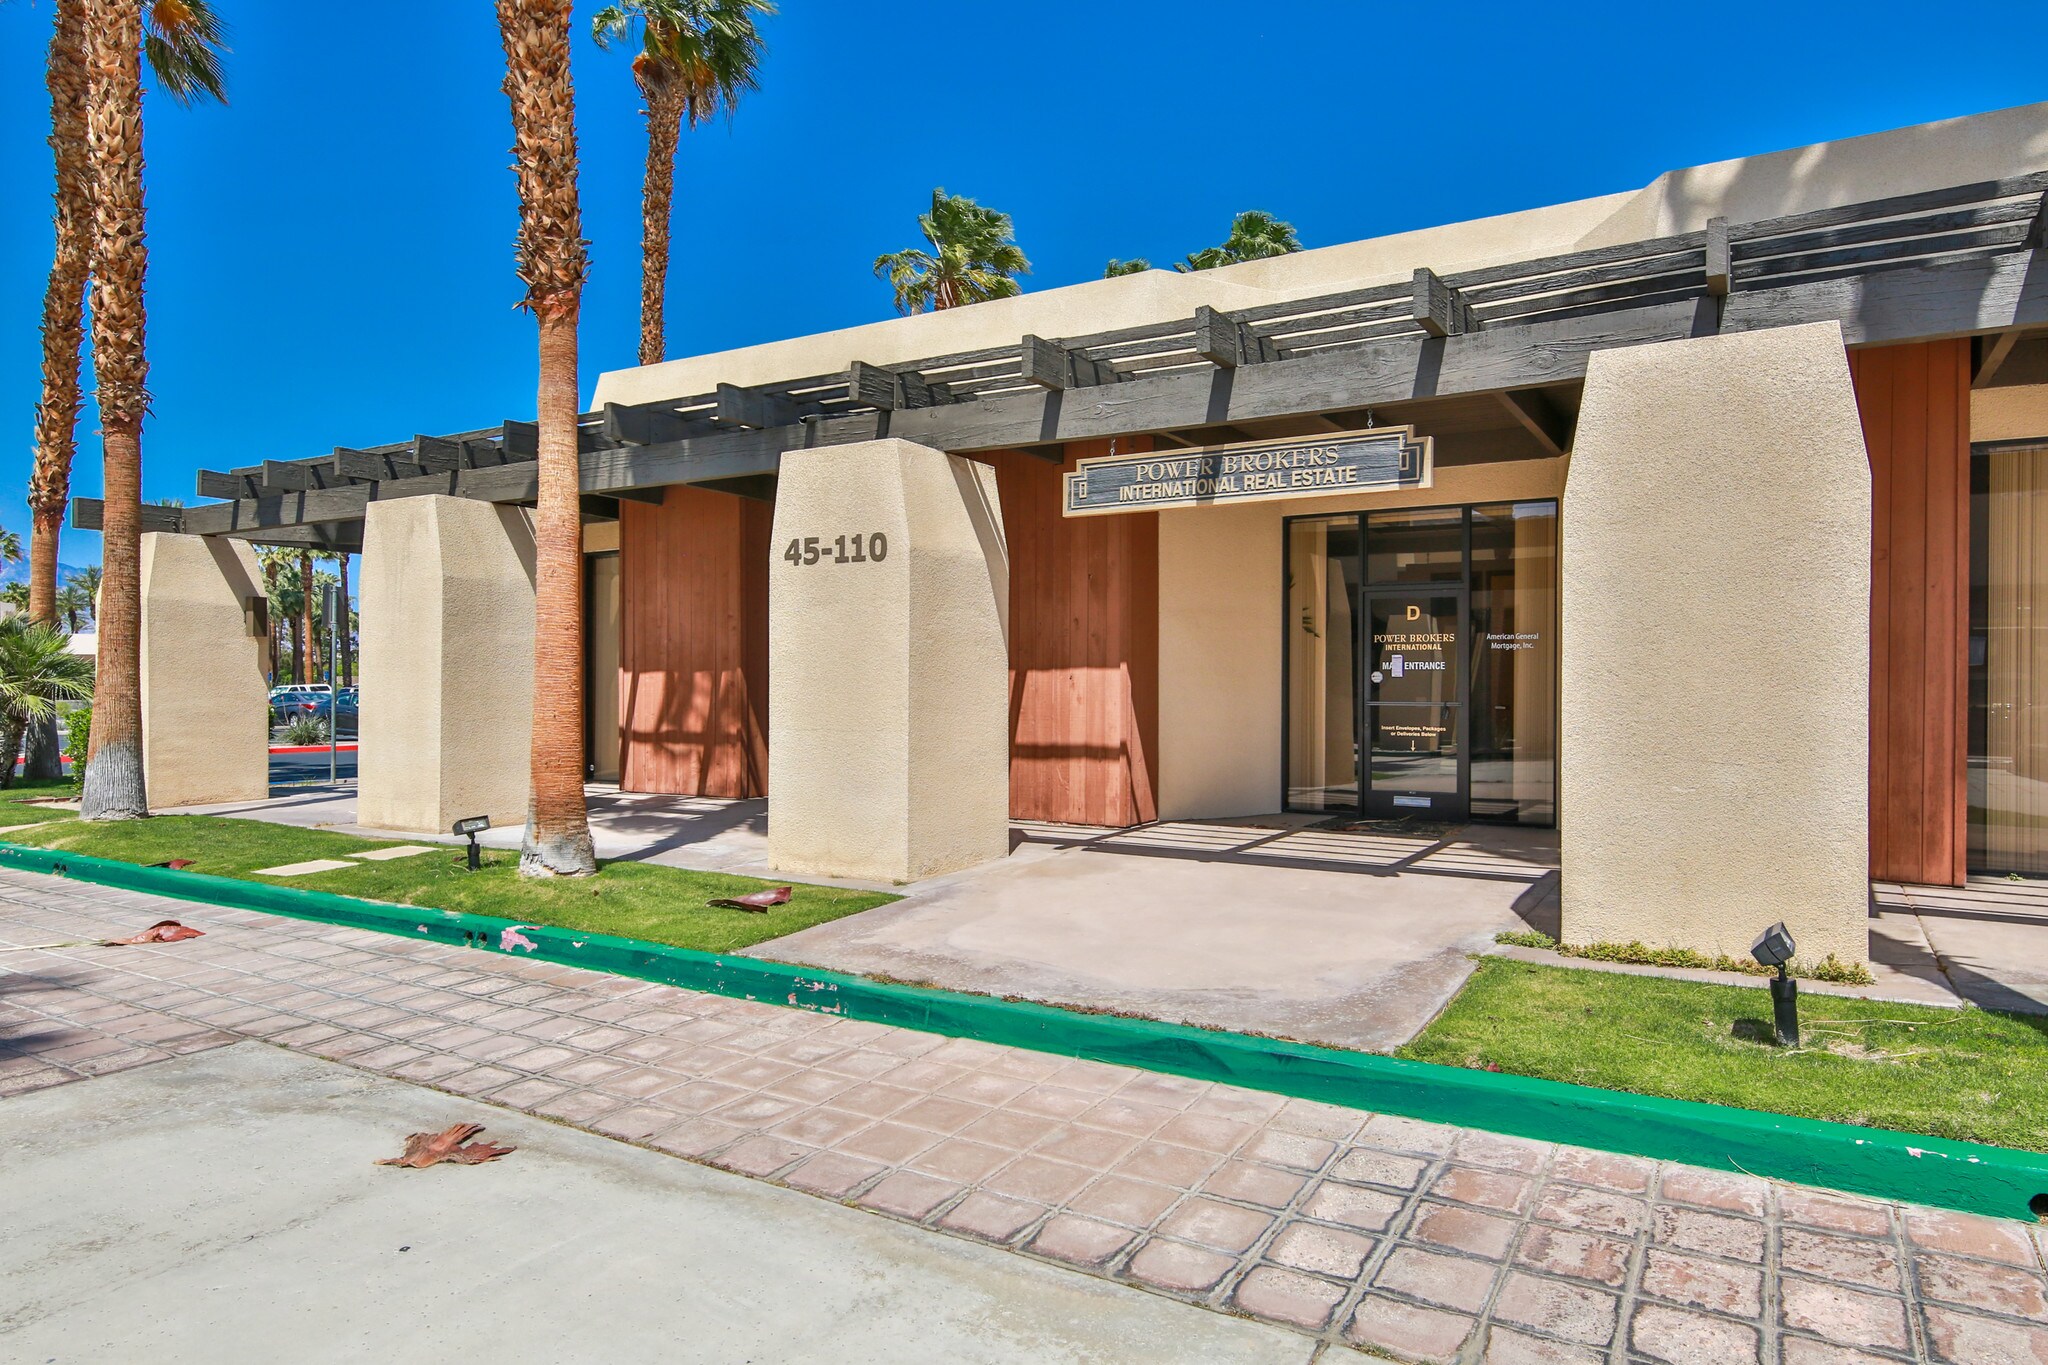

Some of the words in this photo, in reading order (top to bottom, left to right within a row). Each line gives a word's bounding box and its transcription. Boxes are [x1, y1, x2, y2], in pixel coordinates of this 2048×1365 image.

[1136, 457, 1214, 482] POWER
[1222, 445, 1340, 474] BROKERS
[1119, 475, 1240, 502] INTERNATIONAL
[1243, 471, 1288, 491] REAL
[1291, 465, 1358, 487] ESTATE
[783, 531, 888, 567] 45-110
[1406, 605, 1421, 621] D
[1374, 634, 1407, 643] POWER
[1409, 633, 1455, 642] BROKERS
[1385, 643, 1442, 651] INTERNATIONAL
[1491, 642, 1522, 650] Mortgage,
[1404, 661, 1446, 670] ENTRANCE
